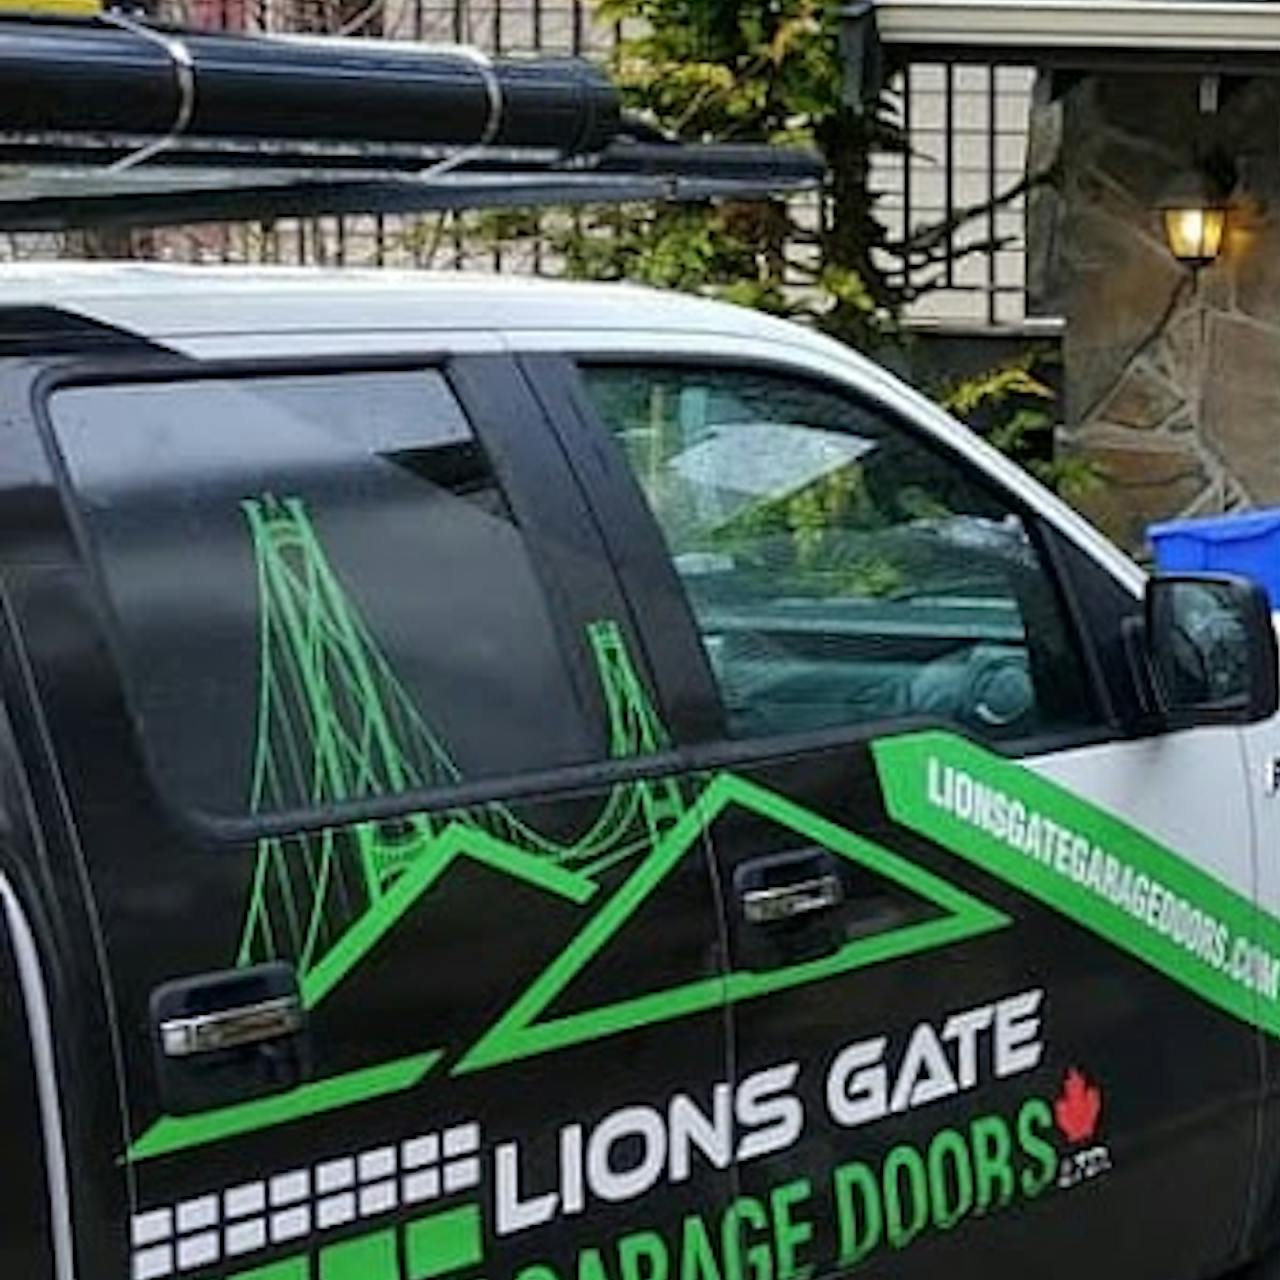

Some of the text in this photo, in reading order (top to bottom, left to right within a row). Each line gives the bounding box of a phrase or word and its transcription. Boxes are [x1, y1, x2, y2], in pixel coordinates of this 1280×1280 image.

[927, 756, 1280, 1001] LIONSGATEGARAGEDOORS.COM
[494, 987, 1046, 1236] LIONS GATE
[833, 1096, 1060, 1269] DOORS
